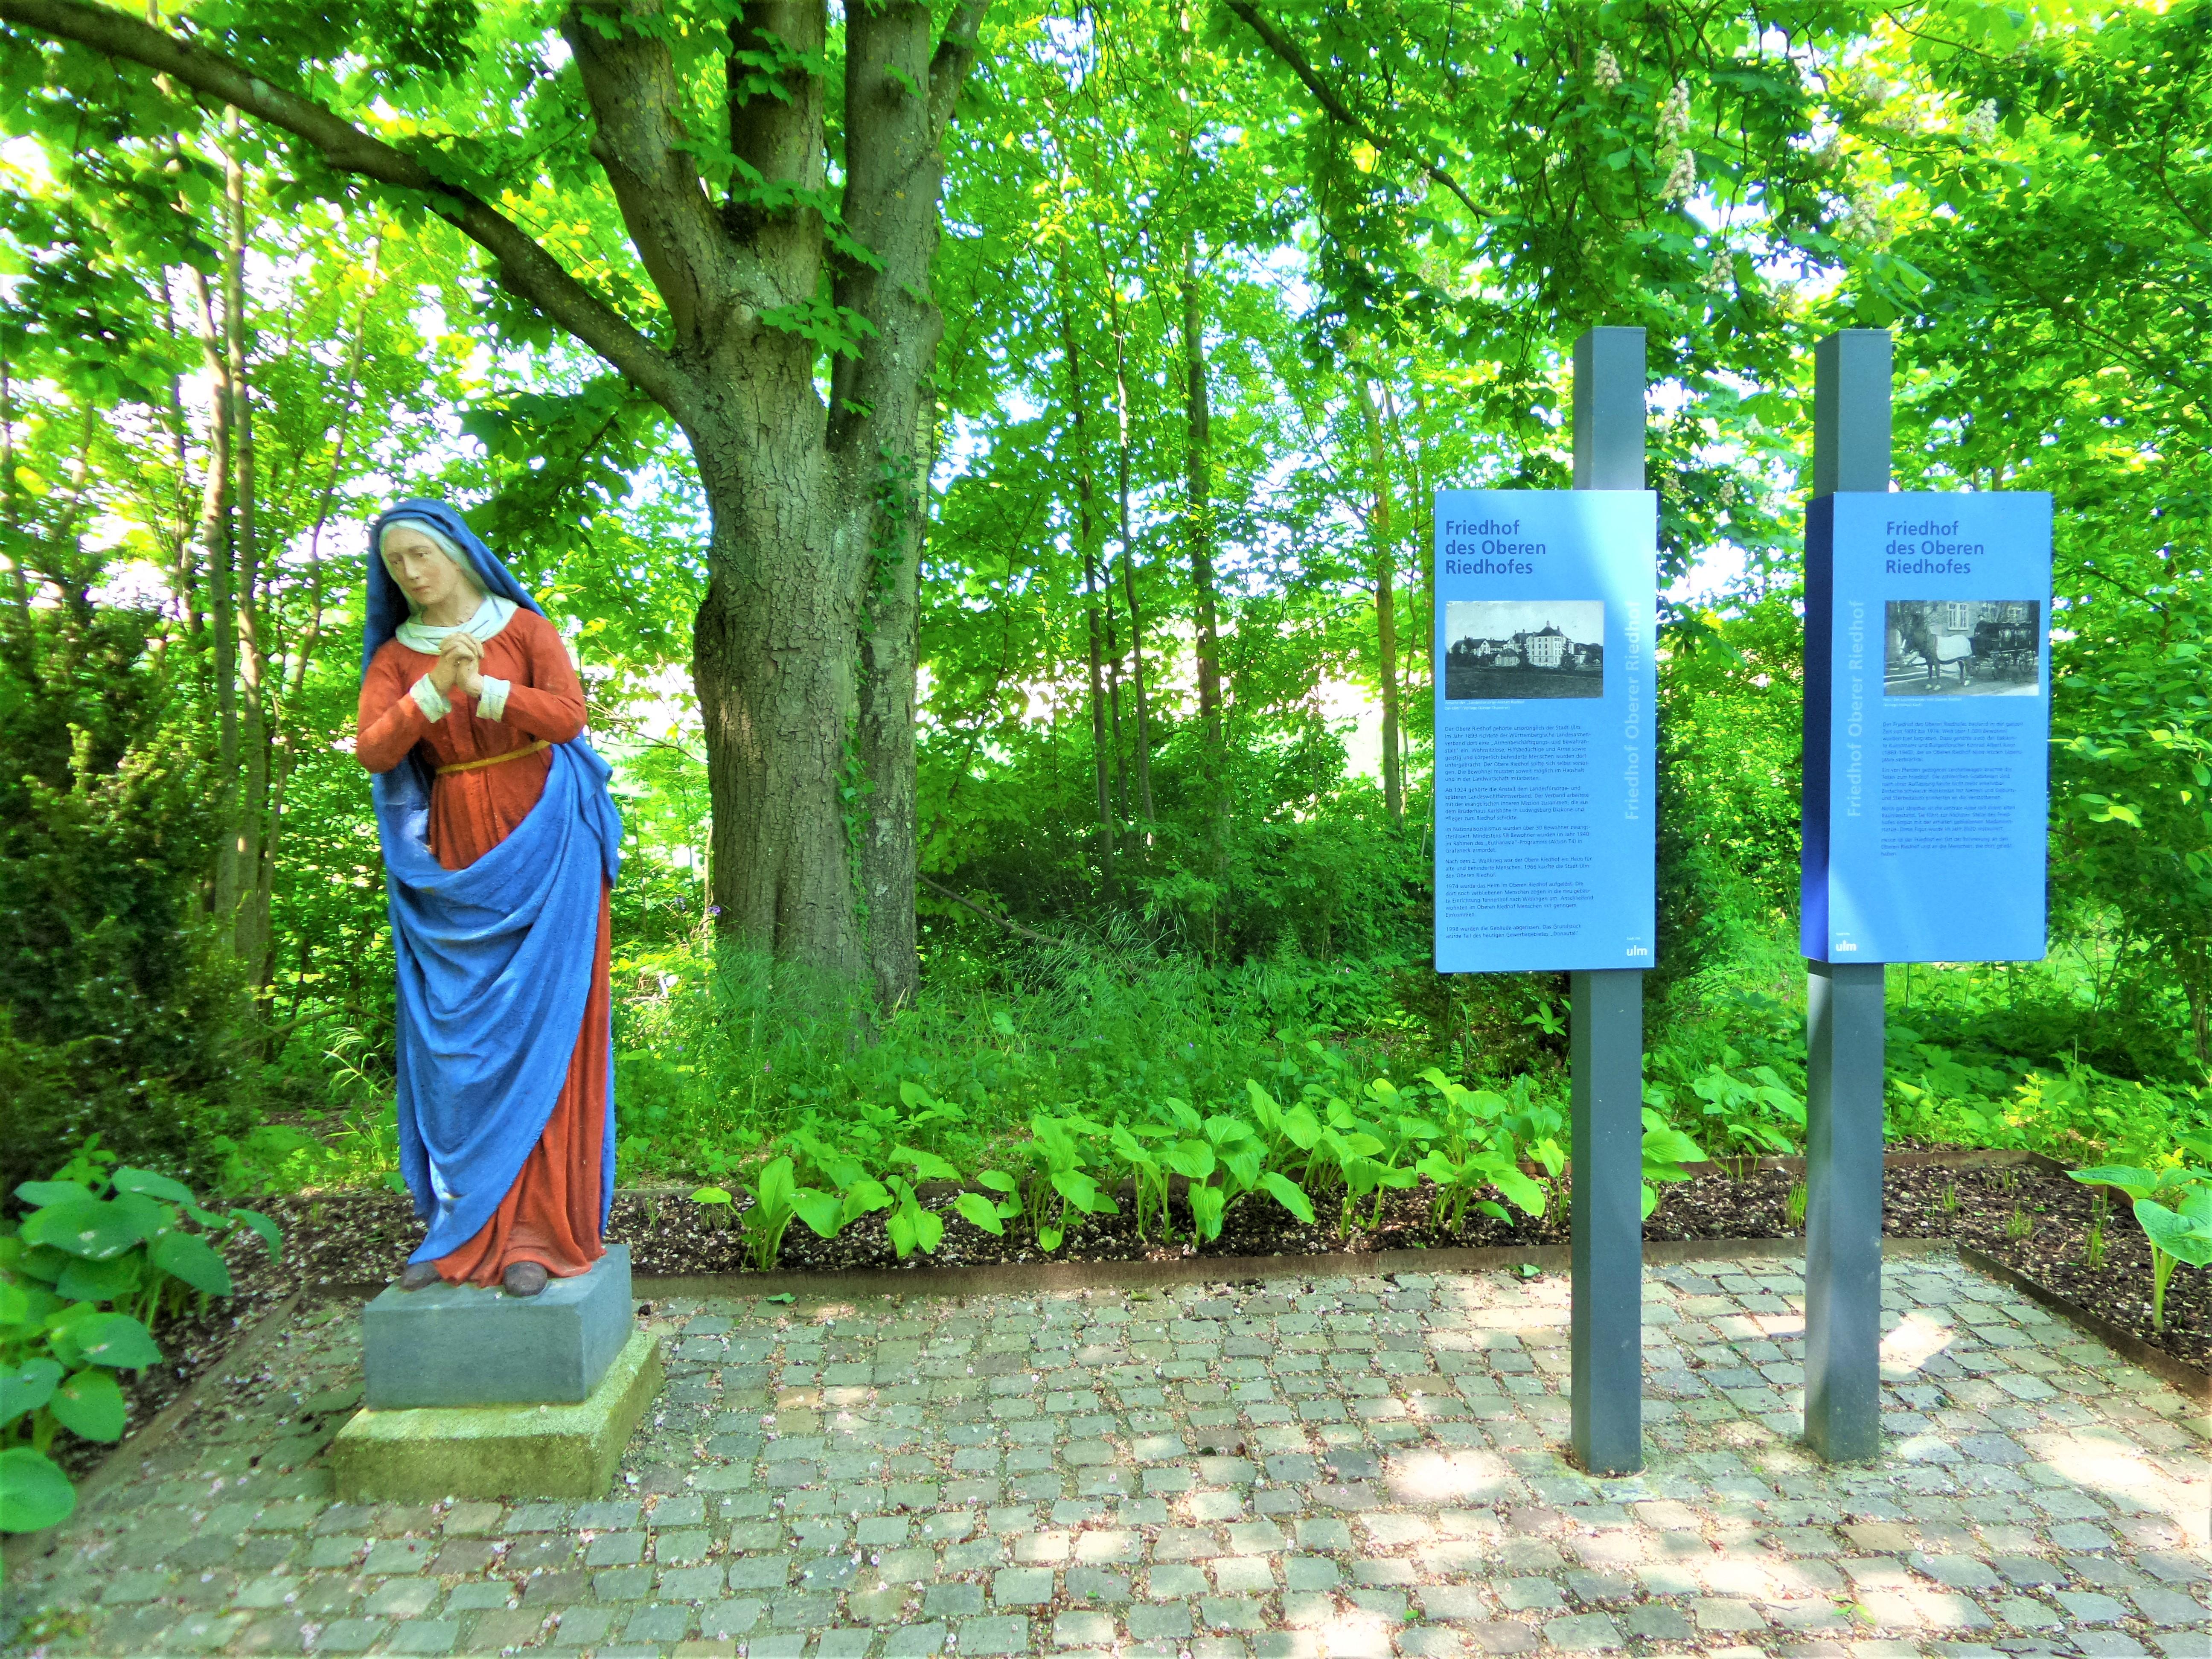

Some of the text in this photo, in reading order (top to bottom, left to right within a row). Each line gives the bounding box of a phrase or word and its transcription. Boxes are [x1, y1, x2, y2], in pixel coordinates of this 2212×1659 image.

[1445, 520, 1520, 535] Friedhof
[1886, 521, 1959, 536] Friedhof
[1445, 539, 1546, 555] des Oberen
[1886, 541, 1984, 555] des Oberen
[1445, 559, 1533, 574] Riedhofes
[1886, 559, 1971, 573] Riedhofes
[1624, 601, 1641, 820] Friedhof Oberer Riedhof
[1847, 600, 1863, 817] Friedhof Oberer Riedhof
[1627, 945, 1647, 956] ulm
[1836, 940, 1857, 952] ulm
